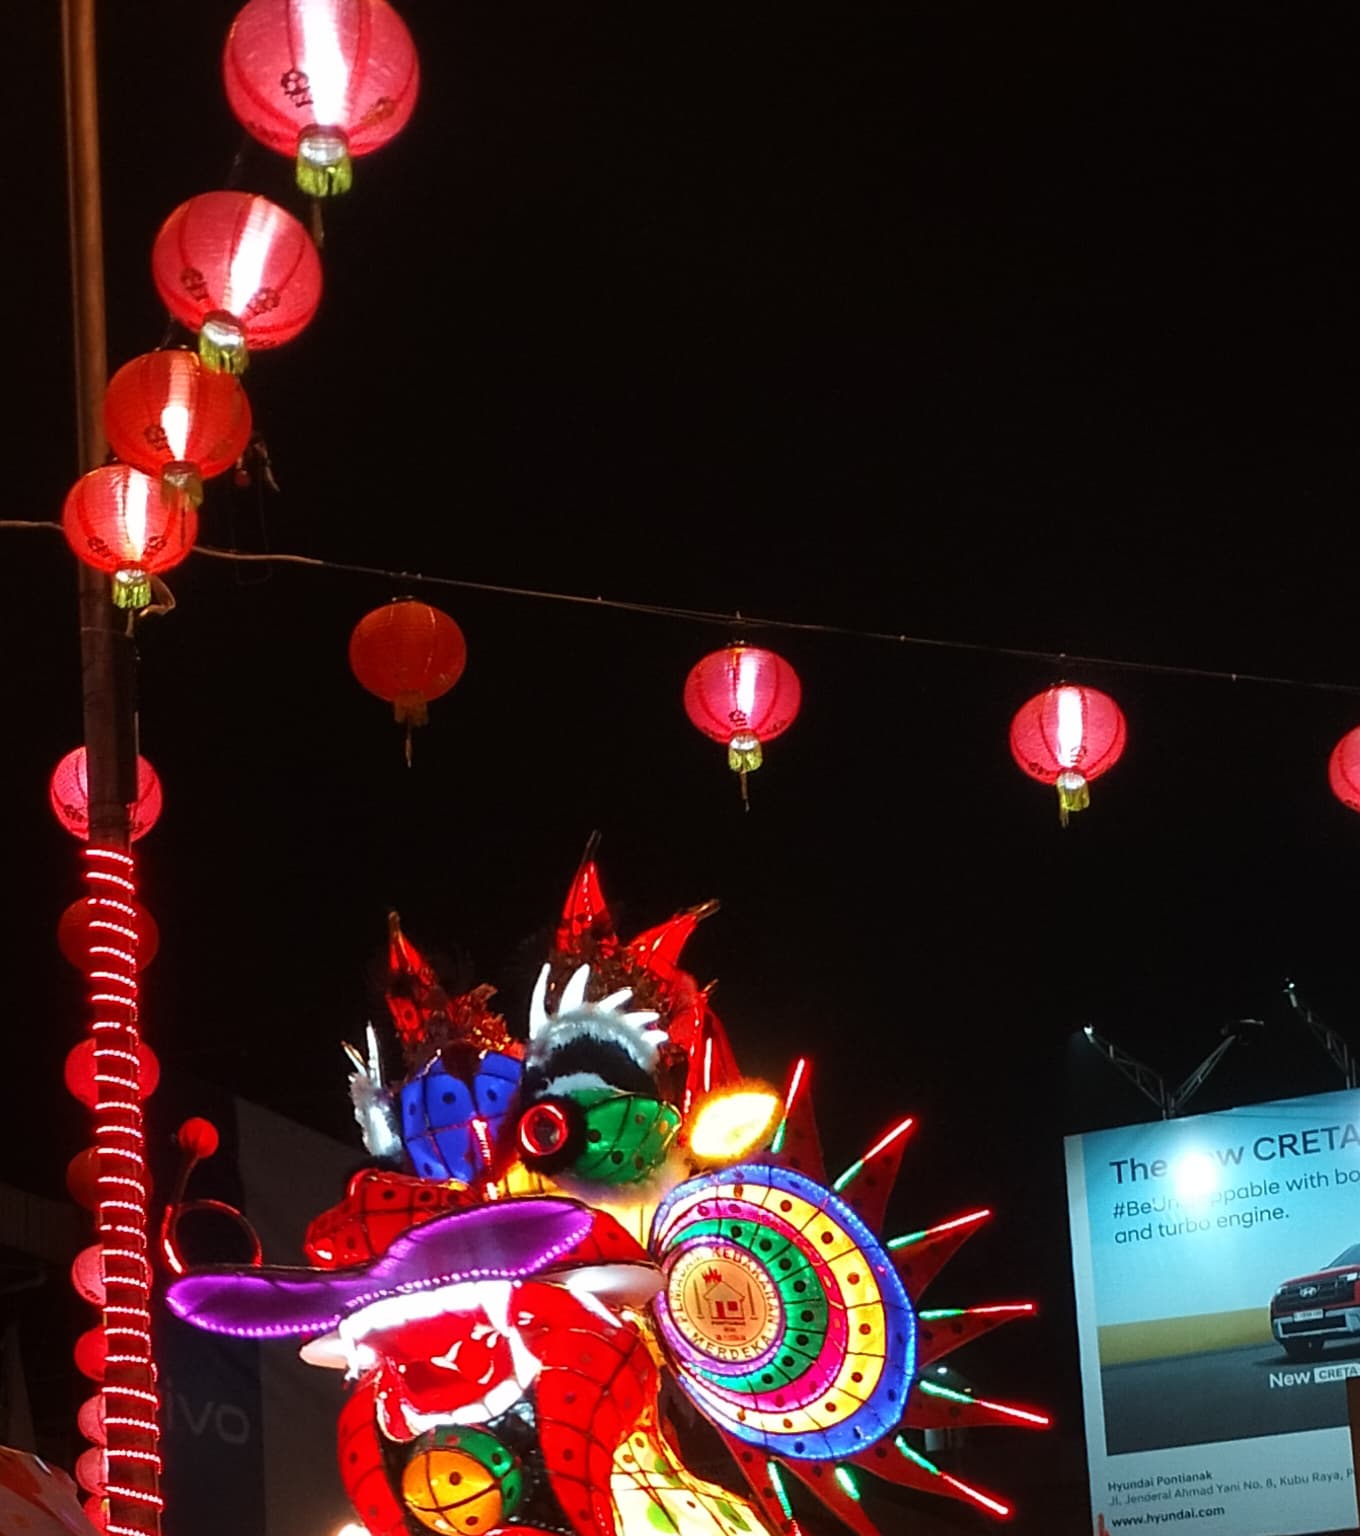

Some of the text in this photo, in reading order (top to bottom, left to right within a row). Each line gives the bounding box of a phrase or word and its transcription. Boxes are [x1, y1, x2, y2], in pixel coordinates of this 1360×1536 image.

[1109, 1157, 1167, 1184] The
[1113, 1179, 1280, 1219] #BeUnppable
[1285, 1170, 1330, 1193] with
[1114, 1205, 1290, 1244] and turbo engine.
[691, 1331, 771, 1360] MERDEKA
[1269, 1366, 1358, 1389] New CRETA
[1107, 1470, 1213, 1492] Hyundai Pontianak
[1112, 1506, 1225, 1527] www.hyundai.com
